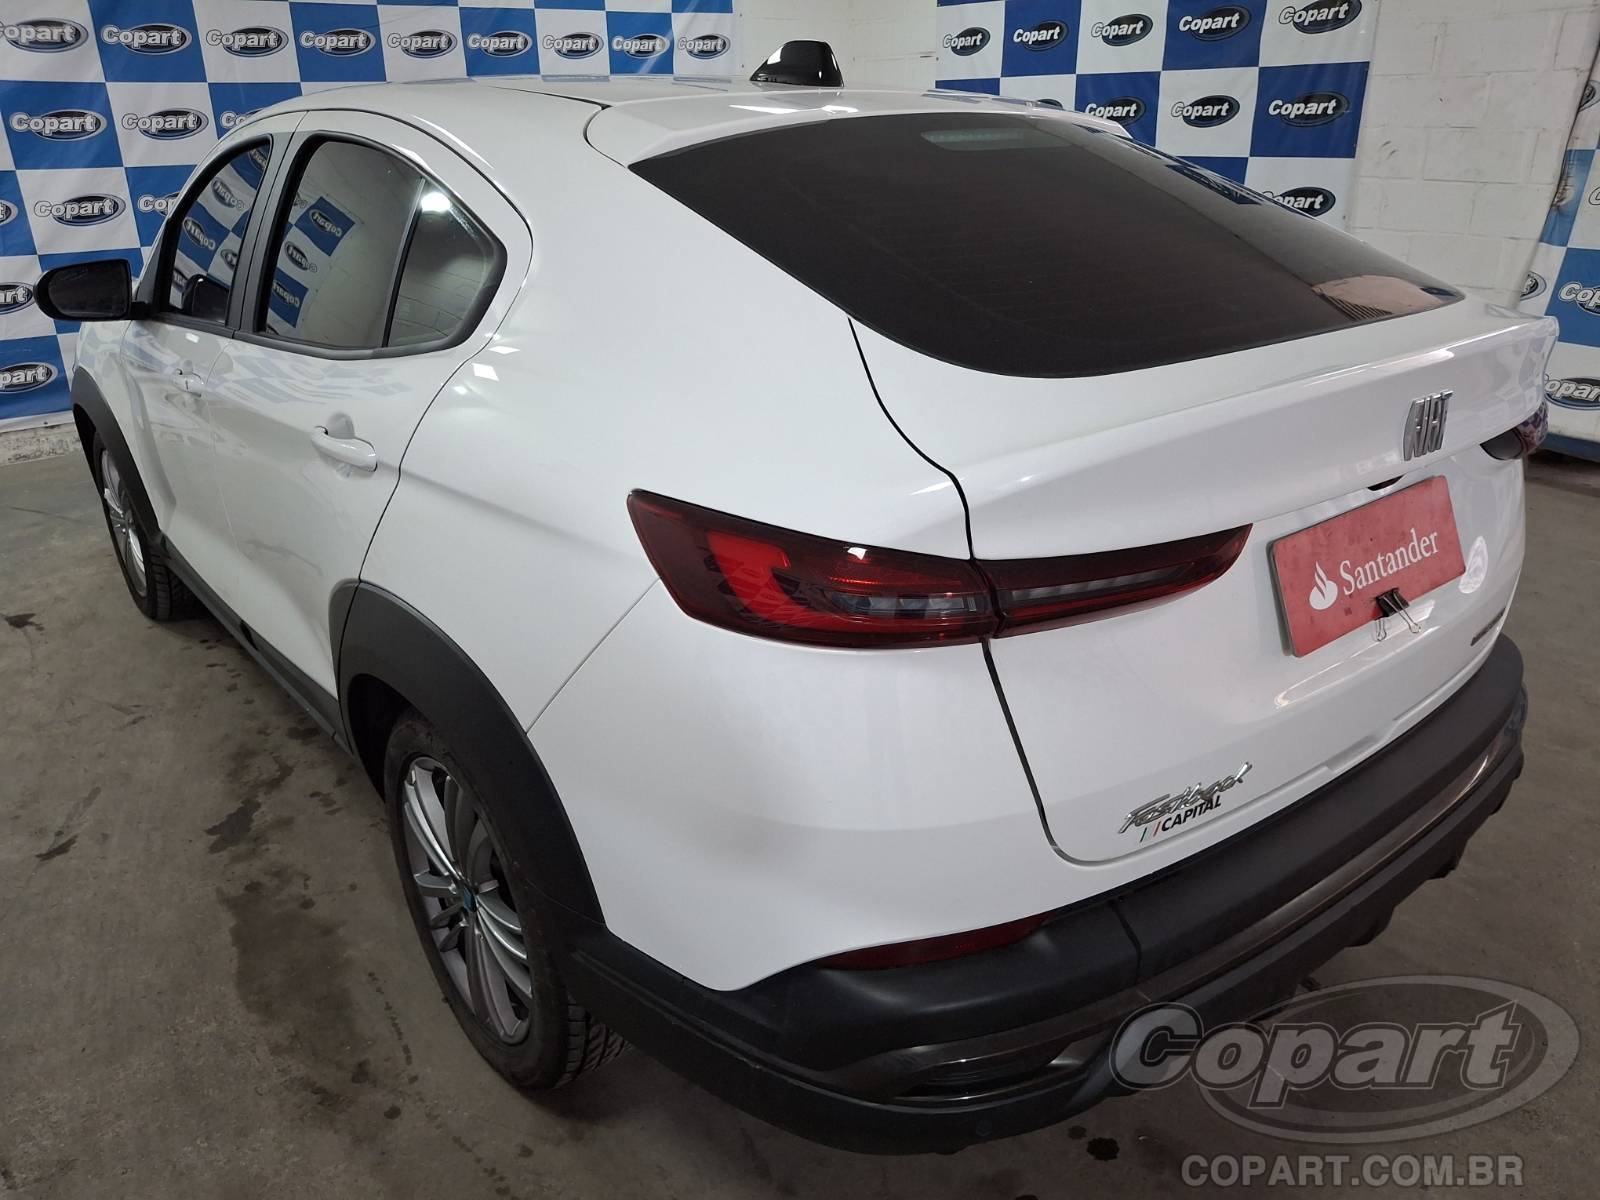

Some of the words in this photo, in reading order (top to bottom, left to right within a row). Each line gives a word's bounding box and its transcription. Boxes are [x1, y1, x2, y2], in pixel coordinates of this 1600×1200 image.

[1178, 10, 1241, 34] Copart
[1278, 1, 1350, 26] Copart
[0, 20, 77, 43] opart
[101, 25, 182, 48] Copart
[205, 29, 279, 50] Copart
[300, 31, 368, 50] Copart
[1013, 25, 1060, 45] Copart
[1091, 19, 1145, 41] Copart
[387, 32, 449, 51] Copart
[468, 32, 525, 51] Copart
[543, 35, 598, 52] Copart
[612, 35, 664, 53] Copart
[678, 37, 724, 53] Copart
[943, 32, 983, 50] Copart
[1085, 101, 1139, 119] Copart
[1170, 101, 1231, 120] Copart
[1268, 97, 1339, 118] Copart
[10, 112, 97, 136] Copart
[122, 112, 197, 134] Copart
[34, 198, 115, 220] Copart
[1338, 527, 1440, 596] Santander
[1161, 794, 1222, 832] CAPITAL
